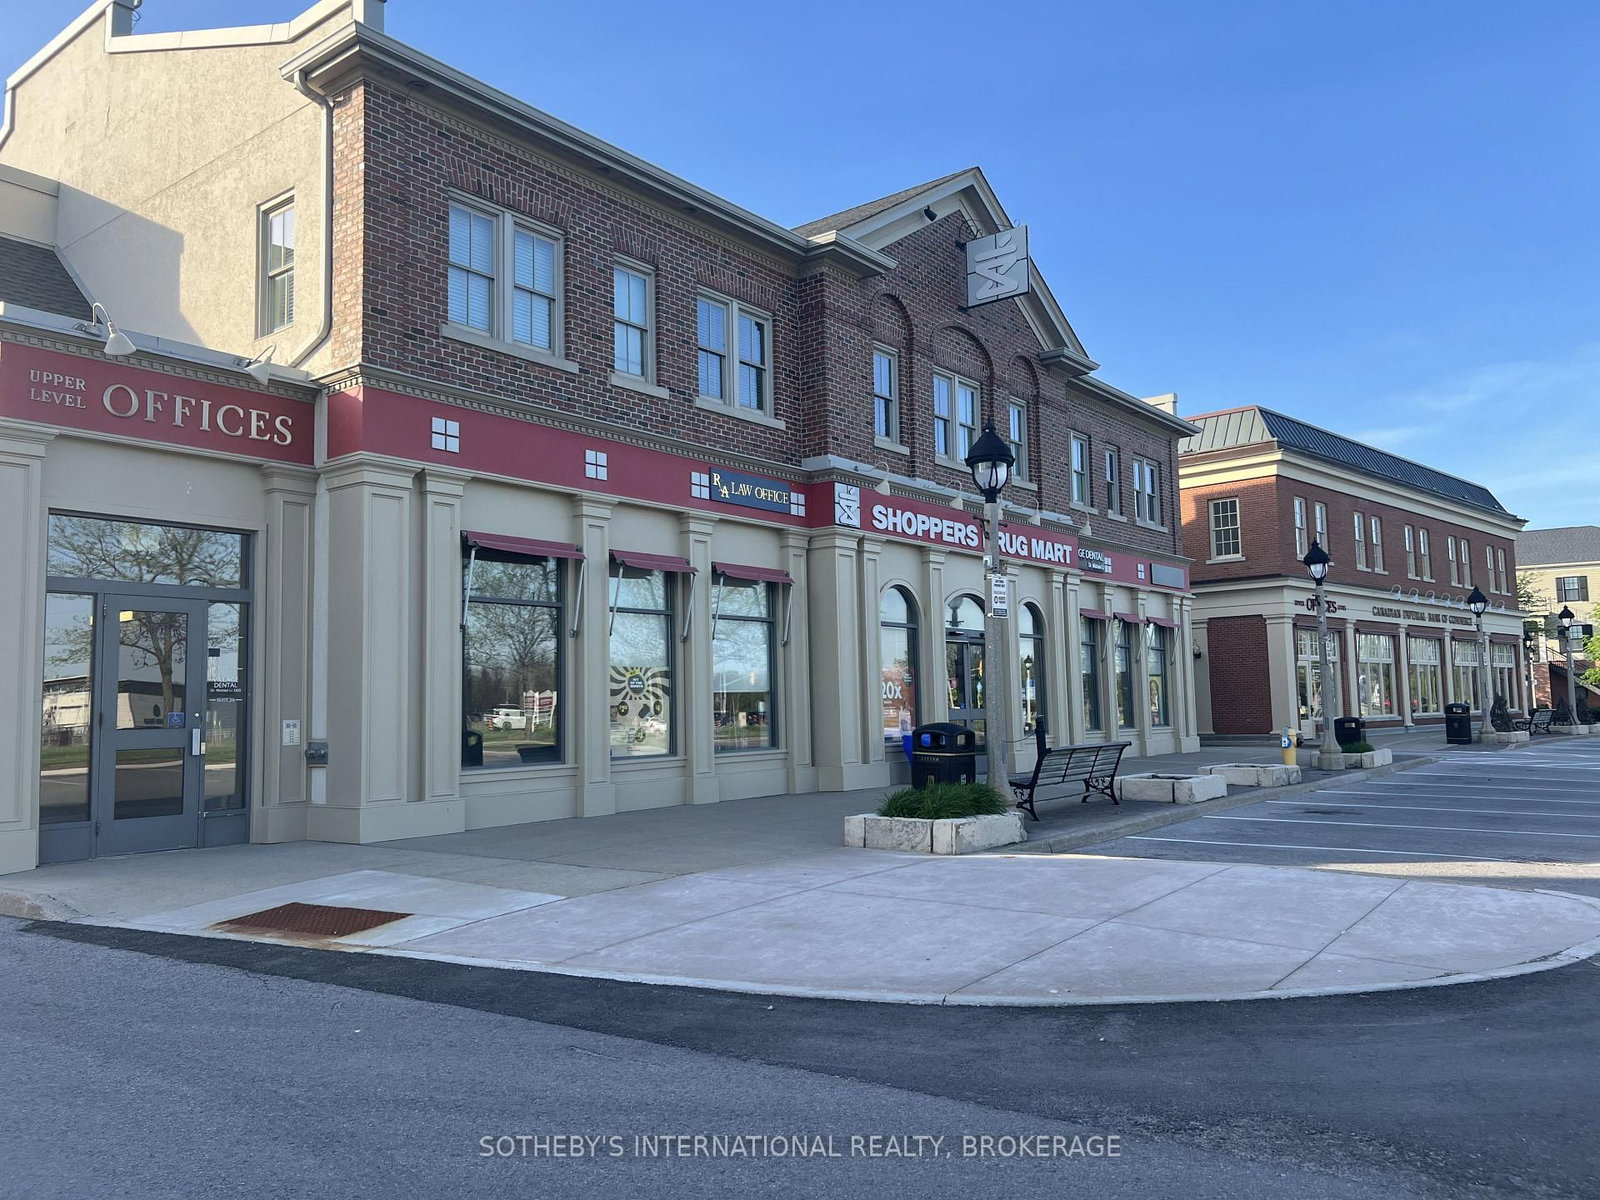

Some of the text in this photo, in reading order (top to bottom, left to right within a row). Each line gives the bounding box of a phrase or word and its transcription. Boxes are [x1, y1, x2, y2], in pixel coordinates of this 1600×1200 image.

[29, 370, 87, 391] UPPER
[29, 388, 87, 409] LEVEL
[102, 384, 293, 446] OFFICES
[731, 481, 753, 497] LAW
[754, 487, 790, 504] OFFICE
[872, 504, 1072, 564] SHOPPERS RUG MART
[1086, 550, 1104, 562] DENTAL
[1372, 606, 1401, 618] CANADIAN
[1428, 612, 1441, 623] BANK
[1441, 614, 1448, 624] OF
[882, 681, 902, 699] 20x
